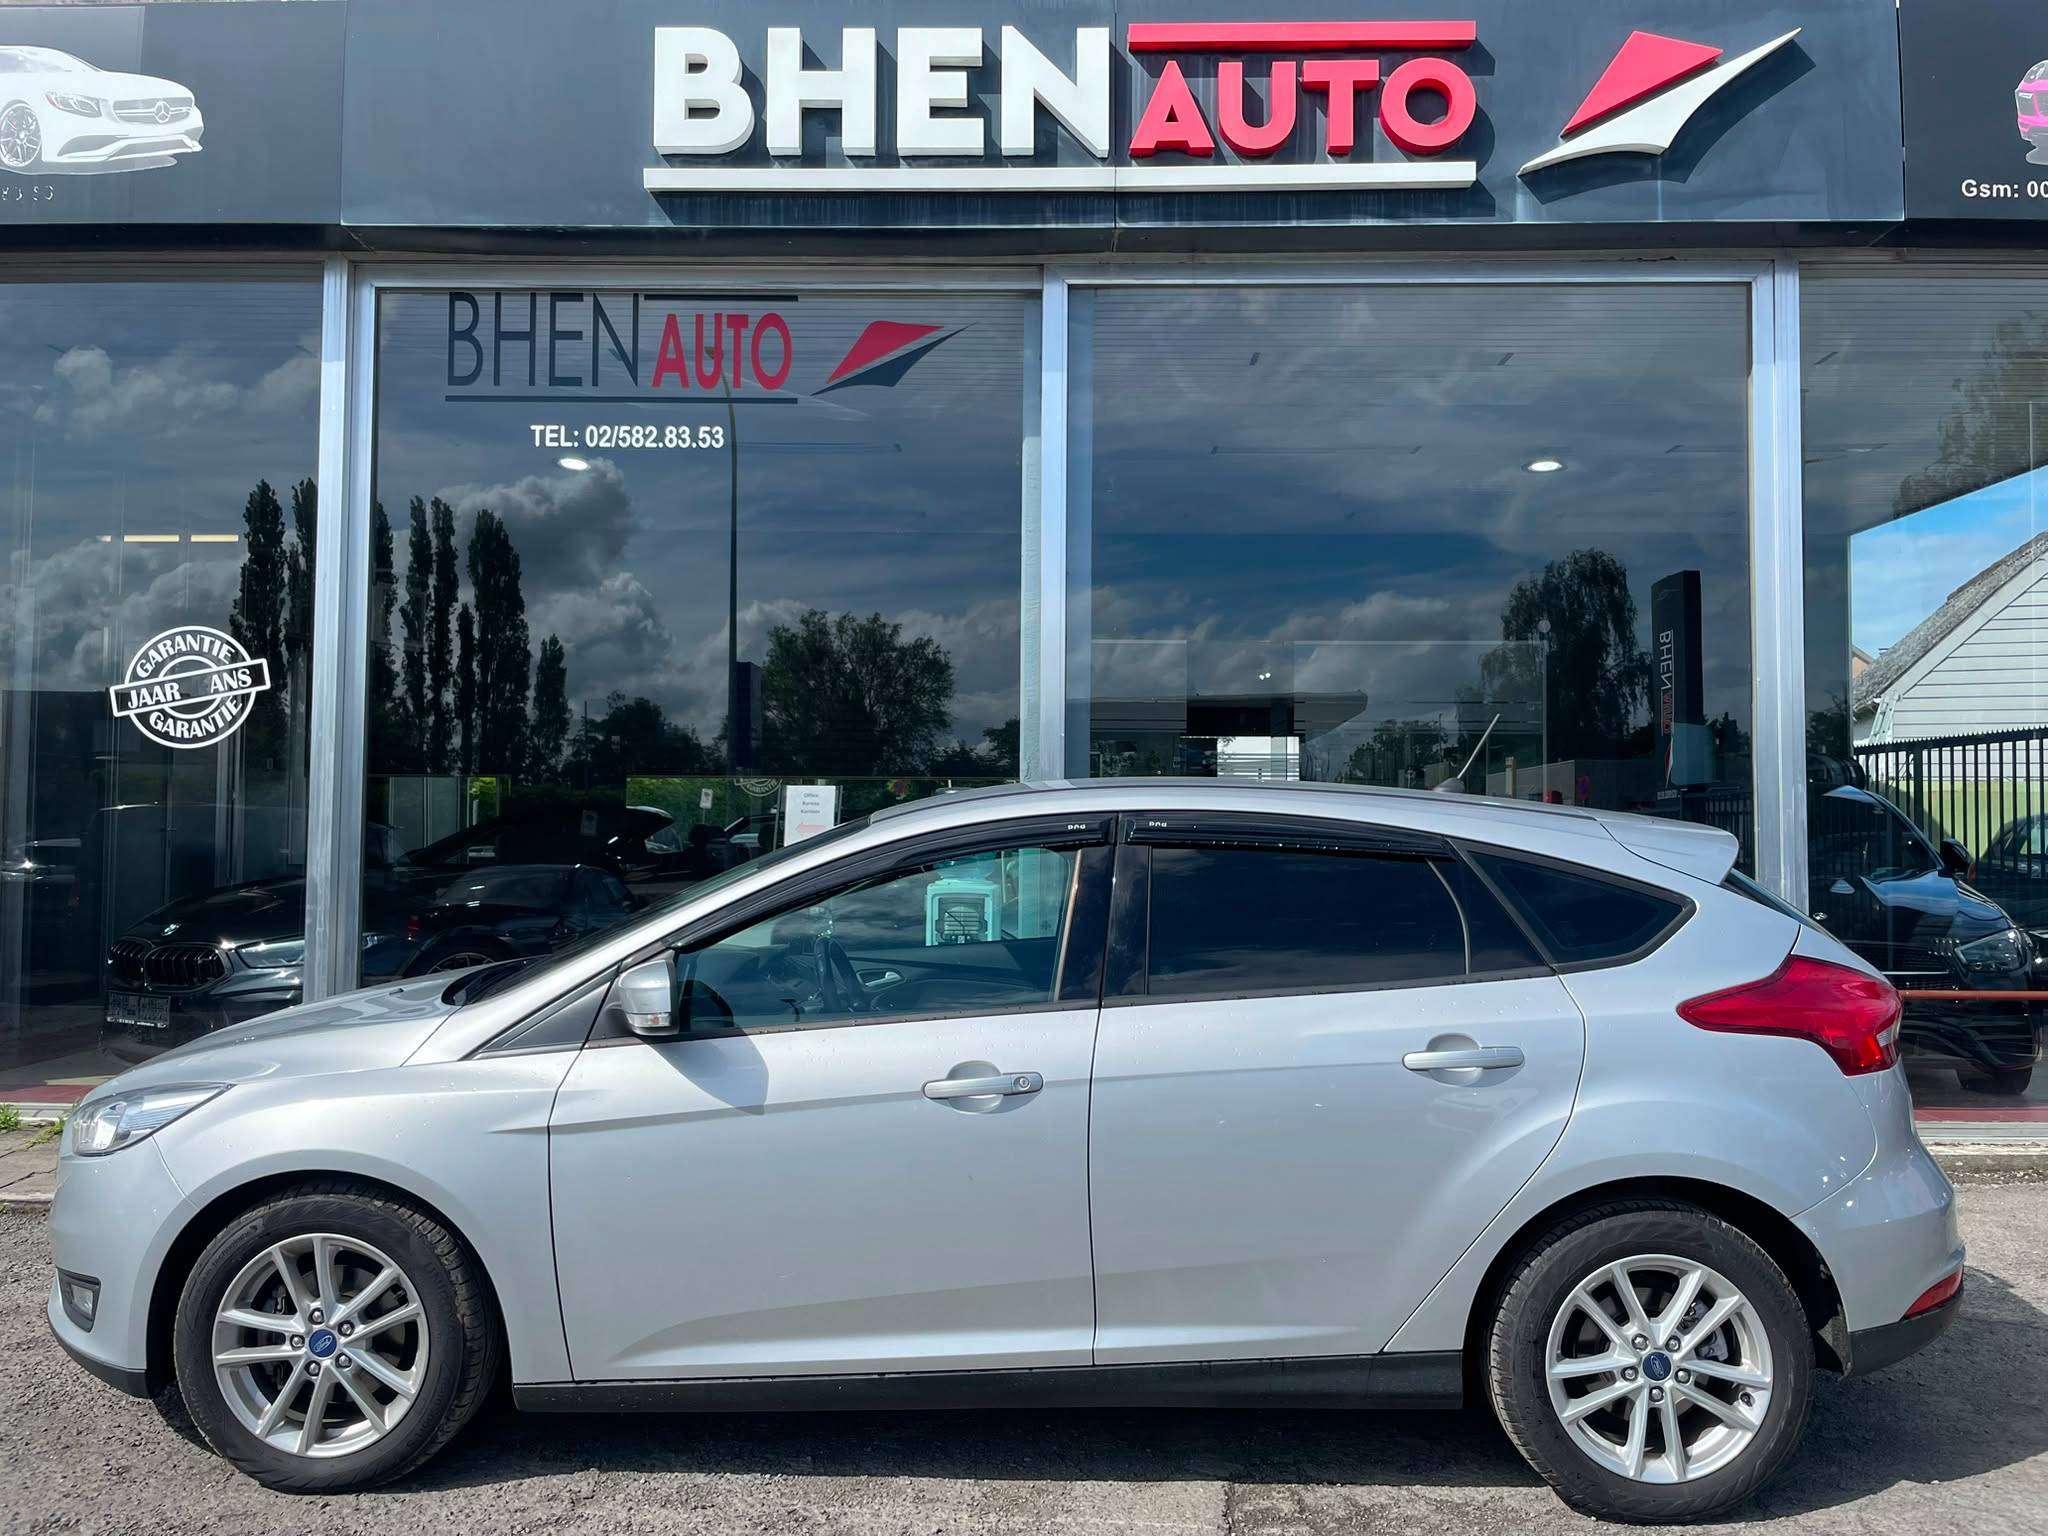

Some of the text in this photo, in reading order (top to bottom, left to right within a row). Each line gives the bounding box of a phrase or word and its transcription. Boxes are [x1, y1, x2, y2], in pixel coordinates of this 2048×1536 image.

[653, 24, 1477, 157] BHEN AUTO
[1961, 178, 2019, 198] Gsm:
[447, 291, 793, 390] BHEN AUTO
[530, 424, 725, 449] TEL: 02/582.83.53
[135, 633, 235, 678] GARANTIE
[127, 668, 252, 709] JAAR ANS
[149, 694, 243, 738] GARANTIE
